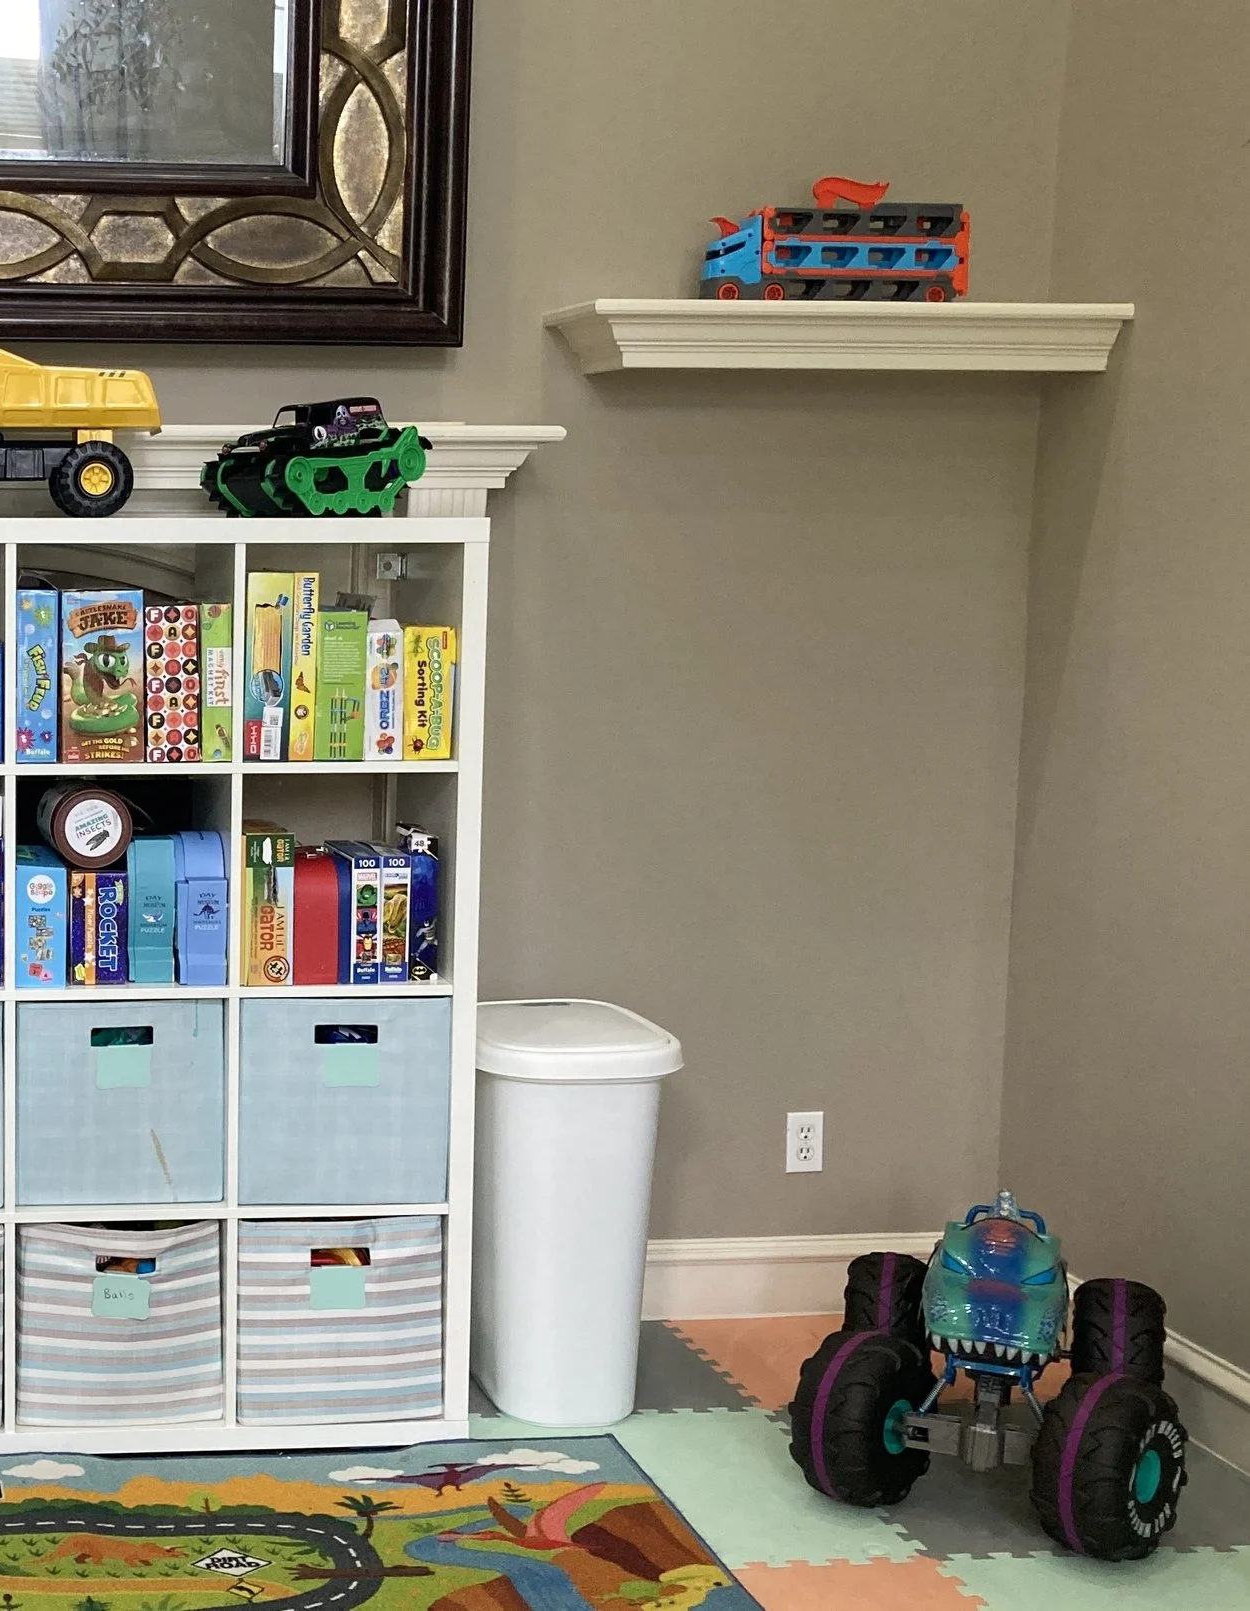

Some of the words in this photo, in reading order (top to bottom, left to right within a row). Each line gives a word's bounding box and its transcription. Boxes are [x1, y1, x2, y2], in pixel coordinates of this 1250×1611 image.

[300, 577, 315, 619] Butterfly
[77, 611, 128, 631] JAKE
[151, 610, 159, 620] F
[169, 627, 177, 637] A
[302, 622, 315, 655] Garden
[151, 646, 160, 656] F
[152, 680, 160, 691] F
[215, 669, 230, 705] first
[415, 660, 427, 706] Sorting
[170, 697, 178, 707] A
[426, 638, 442, 750] SCOOP-A-BUG
[152, 716, 161, 726] F
[418, 711, 427, 728] Kit
[85, 751, 124, 759] STRIKES!
[75, 814, 108, 831] AMAZING
[76, 818, 111, 839] INSECTS
[358, 860, 376, 868] 100
[276, 911, 285, 928] AM
[98, 887, 118, 971] ROCKET
[103, 1288, 135, 1300] Balls
[205, 1561, 260, 1569] ROAD
